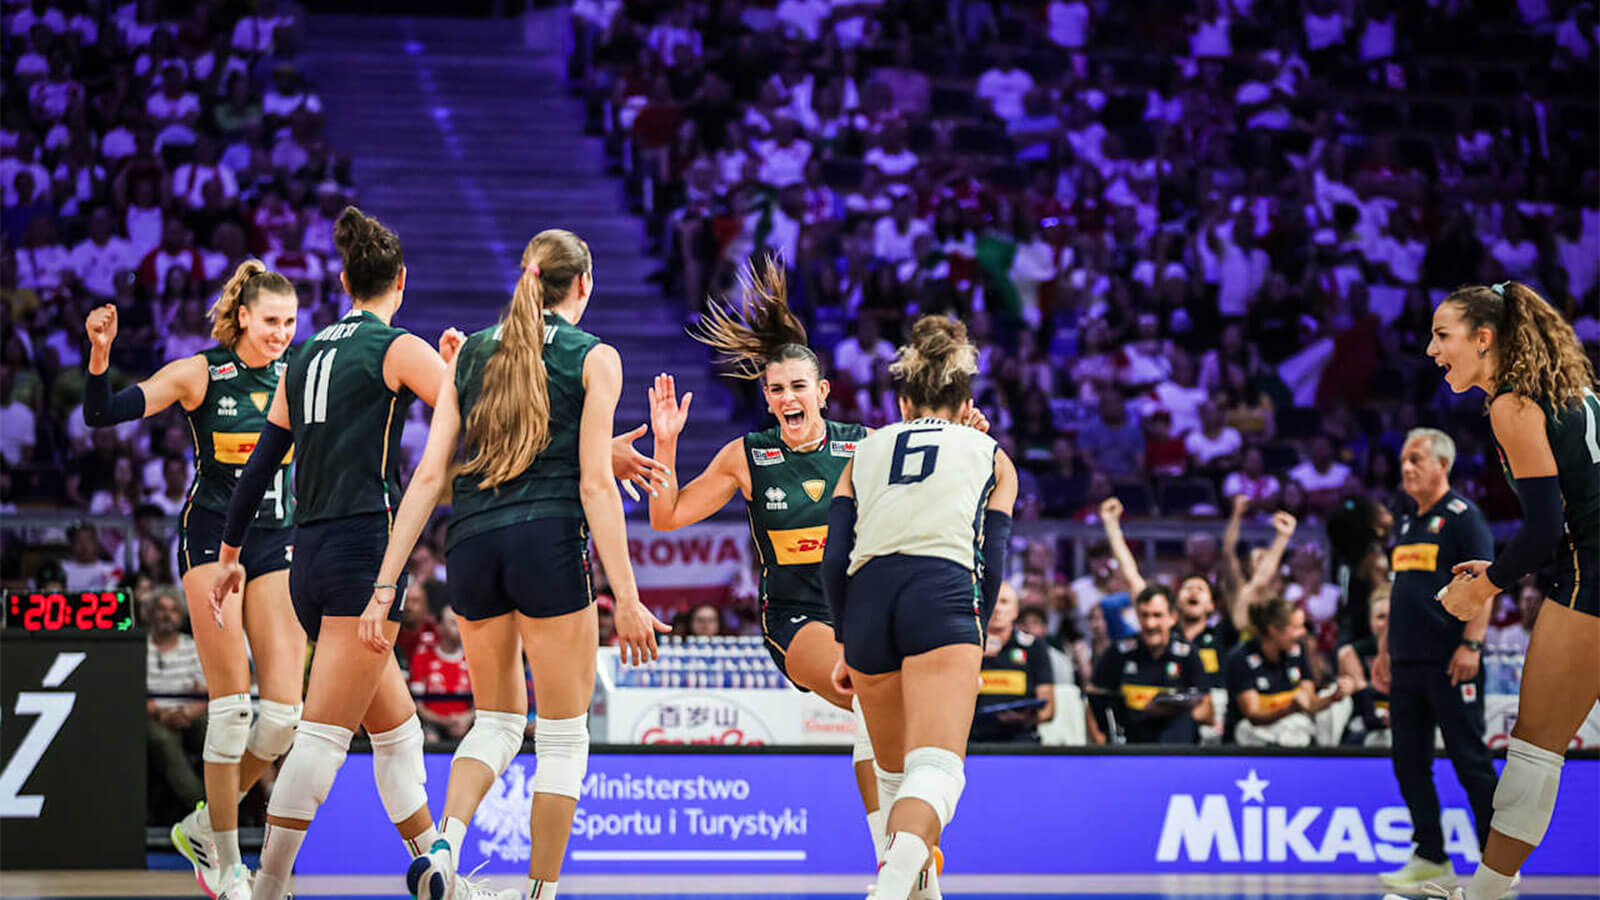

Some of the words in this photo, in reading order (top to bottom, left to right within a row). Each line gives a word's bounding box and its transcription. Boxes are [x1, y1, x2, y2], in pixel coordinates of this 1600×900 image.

[304, 348, 338, 425] 11
[888, 428, 943, 486] 6
[0, 652, 87, 818] Ź
[578, 774, 750, 800] Ministerstwo
[571, 808, 661, 840] Sportu
[669, 809, 676, 834] i
[682, 809, 808, 840] Turystyki
